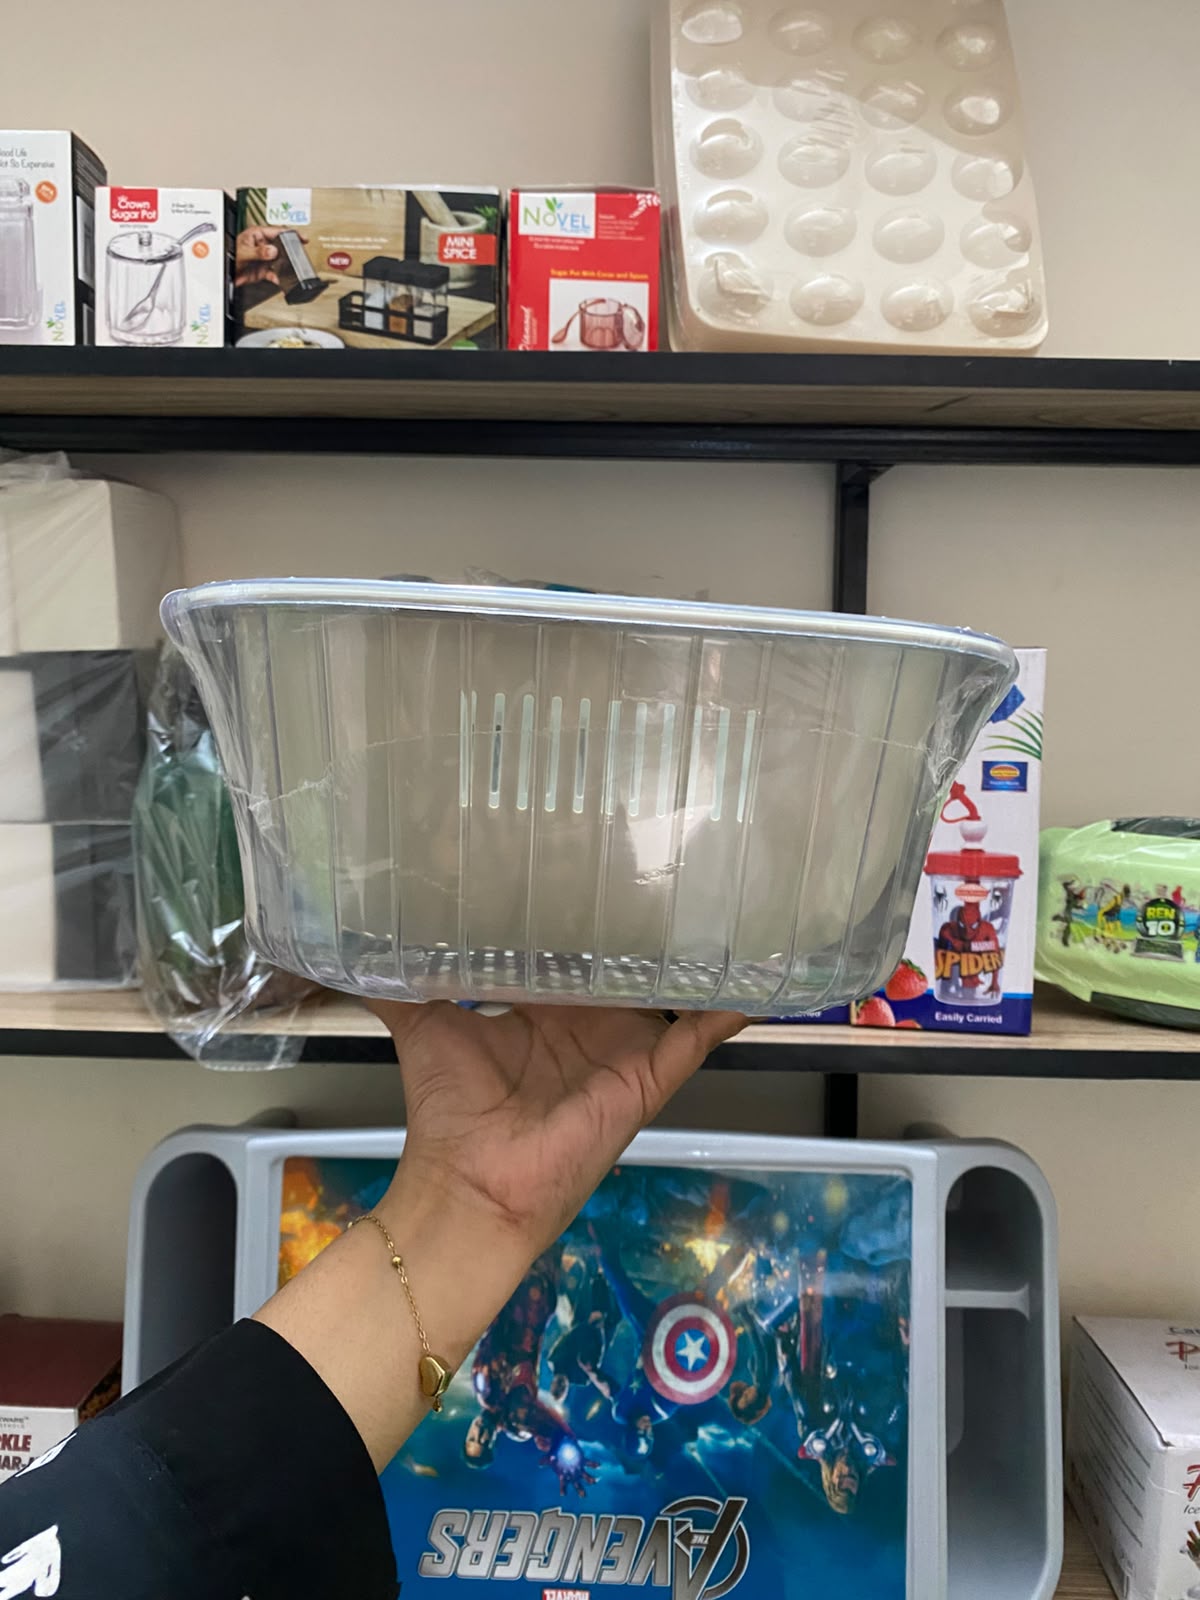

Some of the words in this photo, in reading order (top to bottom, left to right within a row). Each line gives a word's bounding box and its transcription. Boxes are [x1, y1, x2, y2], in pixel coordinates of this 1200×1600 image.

[117, 198, 151, 210] Crown
[111, 208, 140, 221] Sugar
[140, 209, 158, 220] Pot
[446, 235, 474, 247] MINI
[443, 247, 477, 260] SPICE
[329, 256, 351, 266] NEW
[1146, 920, 1176, 936] 10
[934, 1011, 964, 1024] Easily
[966, 1012, 1003, 1024] Carried
[0, 1433, 32, 1452] KLE
[418, 1496, 749, 1600] AVENGERS
